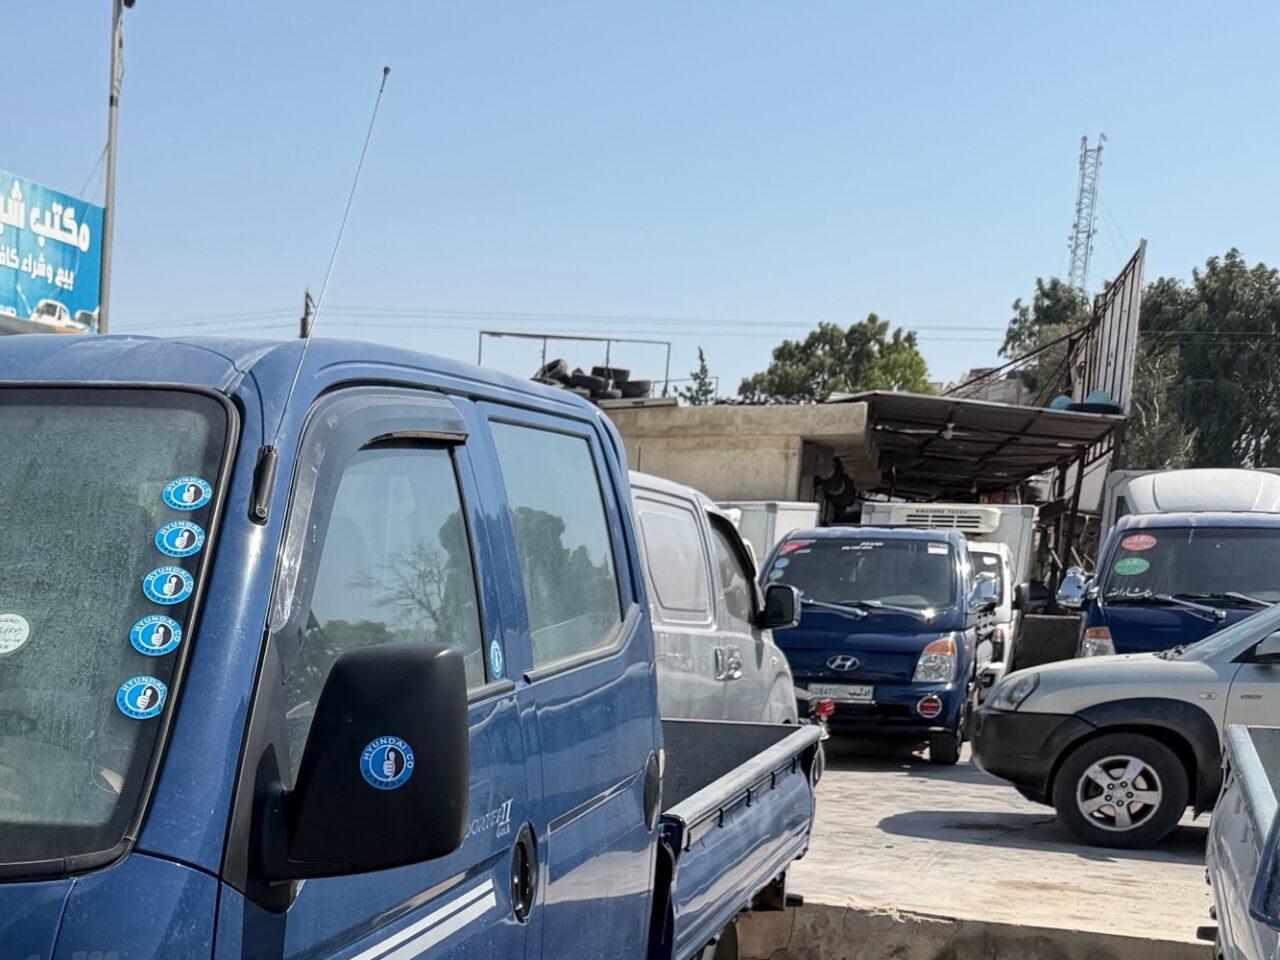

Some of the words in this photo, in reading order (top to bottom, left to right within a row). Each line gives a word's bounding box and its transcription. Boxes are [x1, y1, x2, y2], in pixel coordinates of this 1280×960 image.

[29, 202, 90, 252] مكتب
[21, 252, 53, 284] وشراء
[55, 267, 75, 291] بيع
